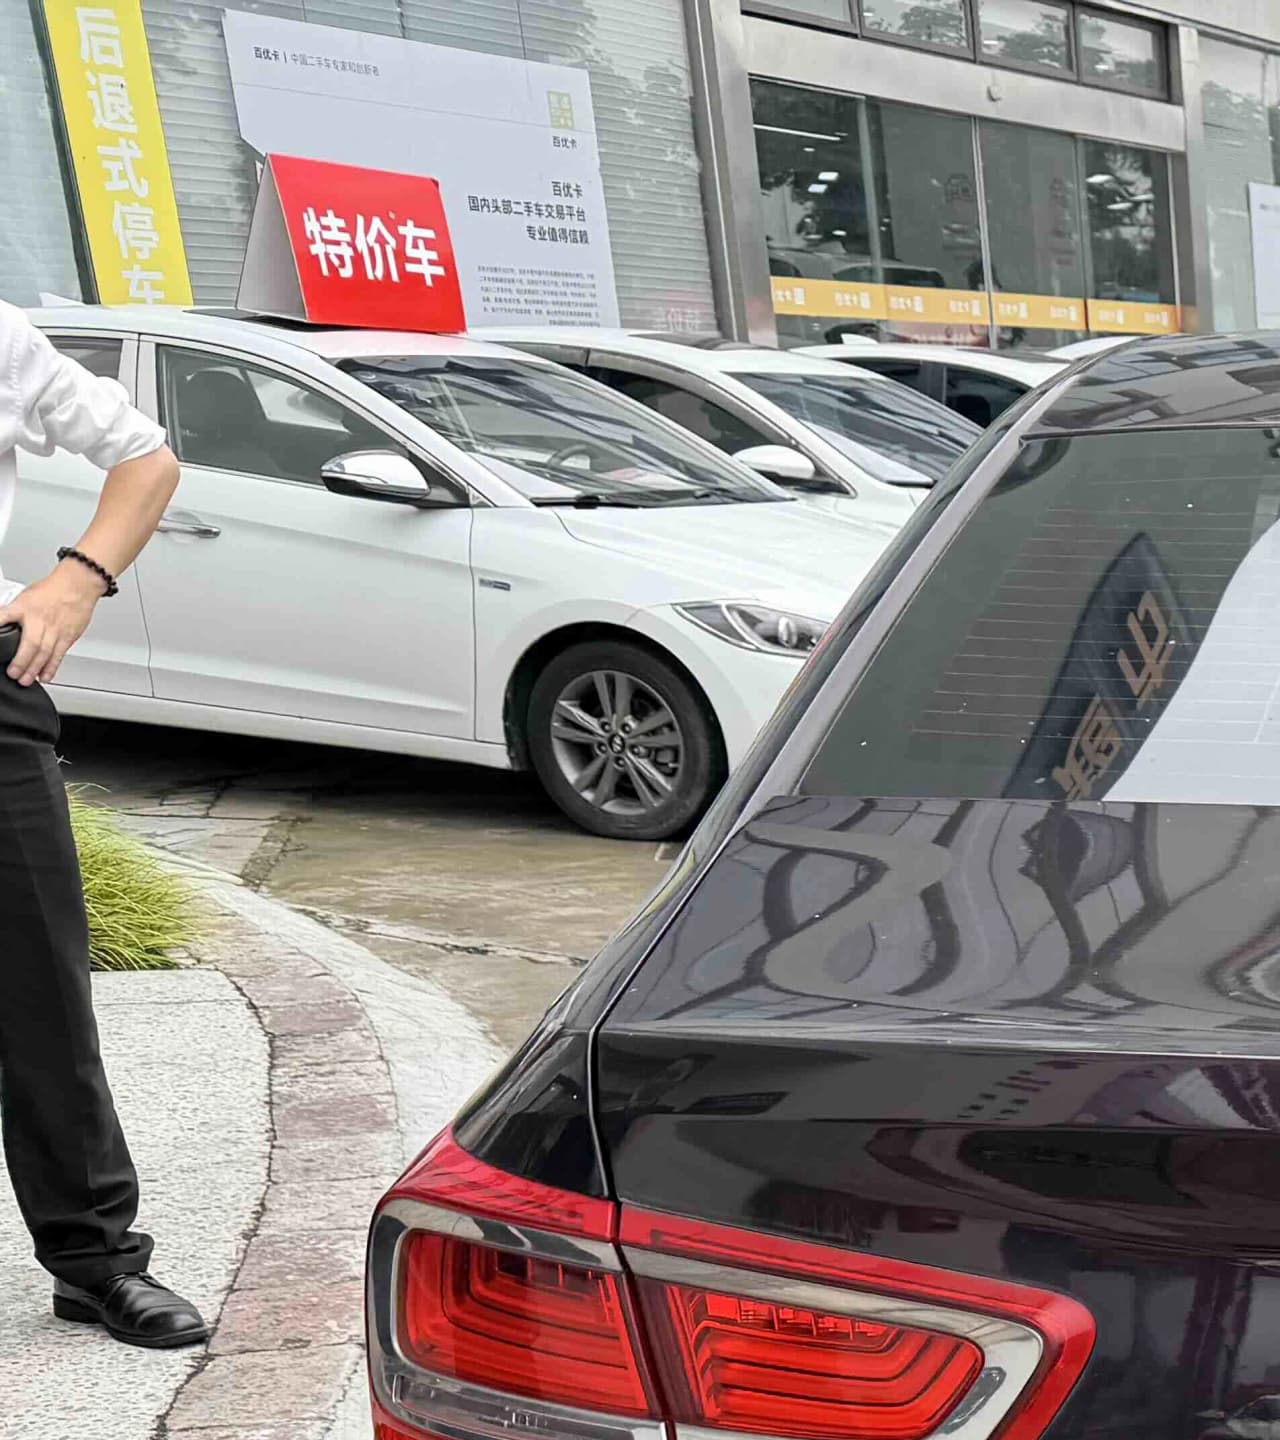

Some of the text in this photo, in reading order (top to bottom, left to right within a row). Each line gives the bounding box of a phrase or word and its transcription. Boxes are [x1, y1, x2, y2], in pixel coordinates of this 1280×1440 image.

[75, 6, 165, 304] 后退式停车
[551, 181, 584, 199] 百优卡
[467, 195, 587, 222] 国内头部二手车交易平台
[303, 206, 446, 287] 特价车
[526, 225, 590, 245] 专业值得信赖
